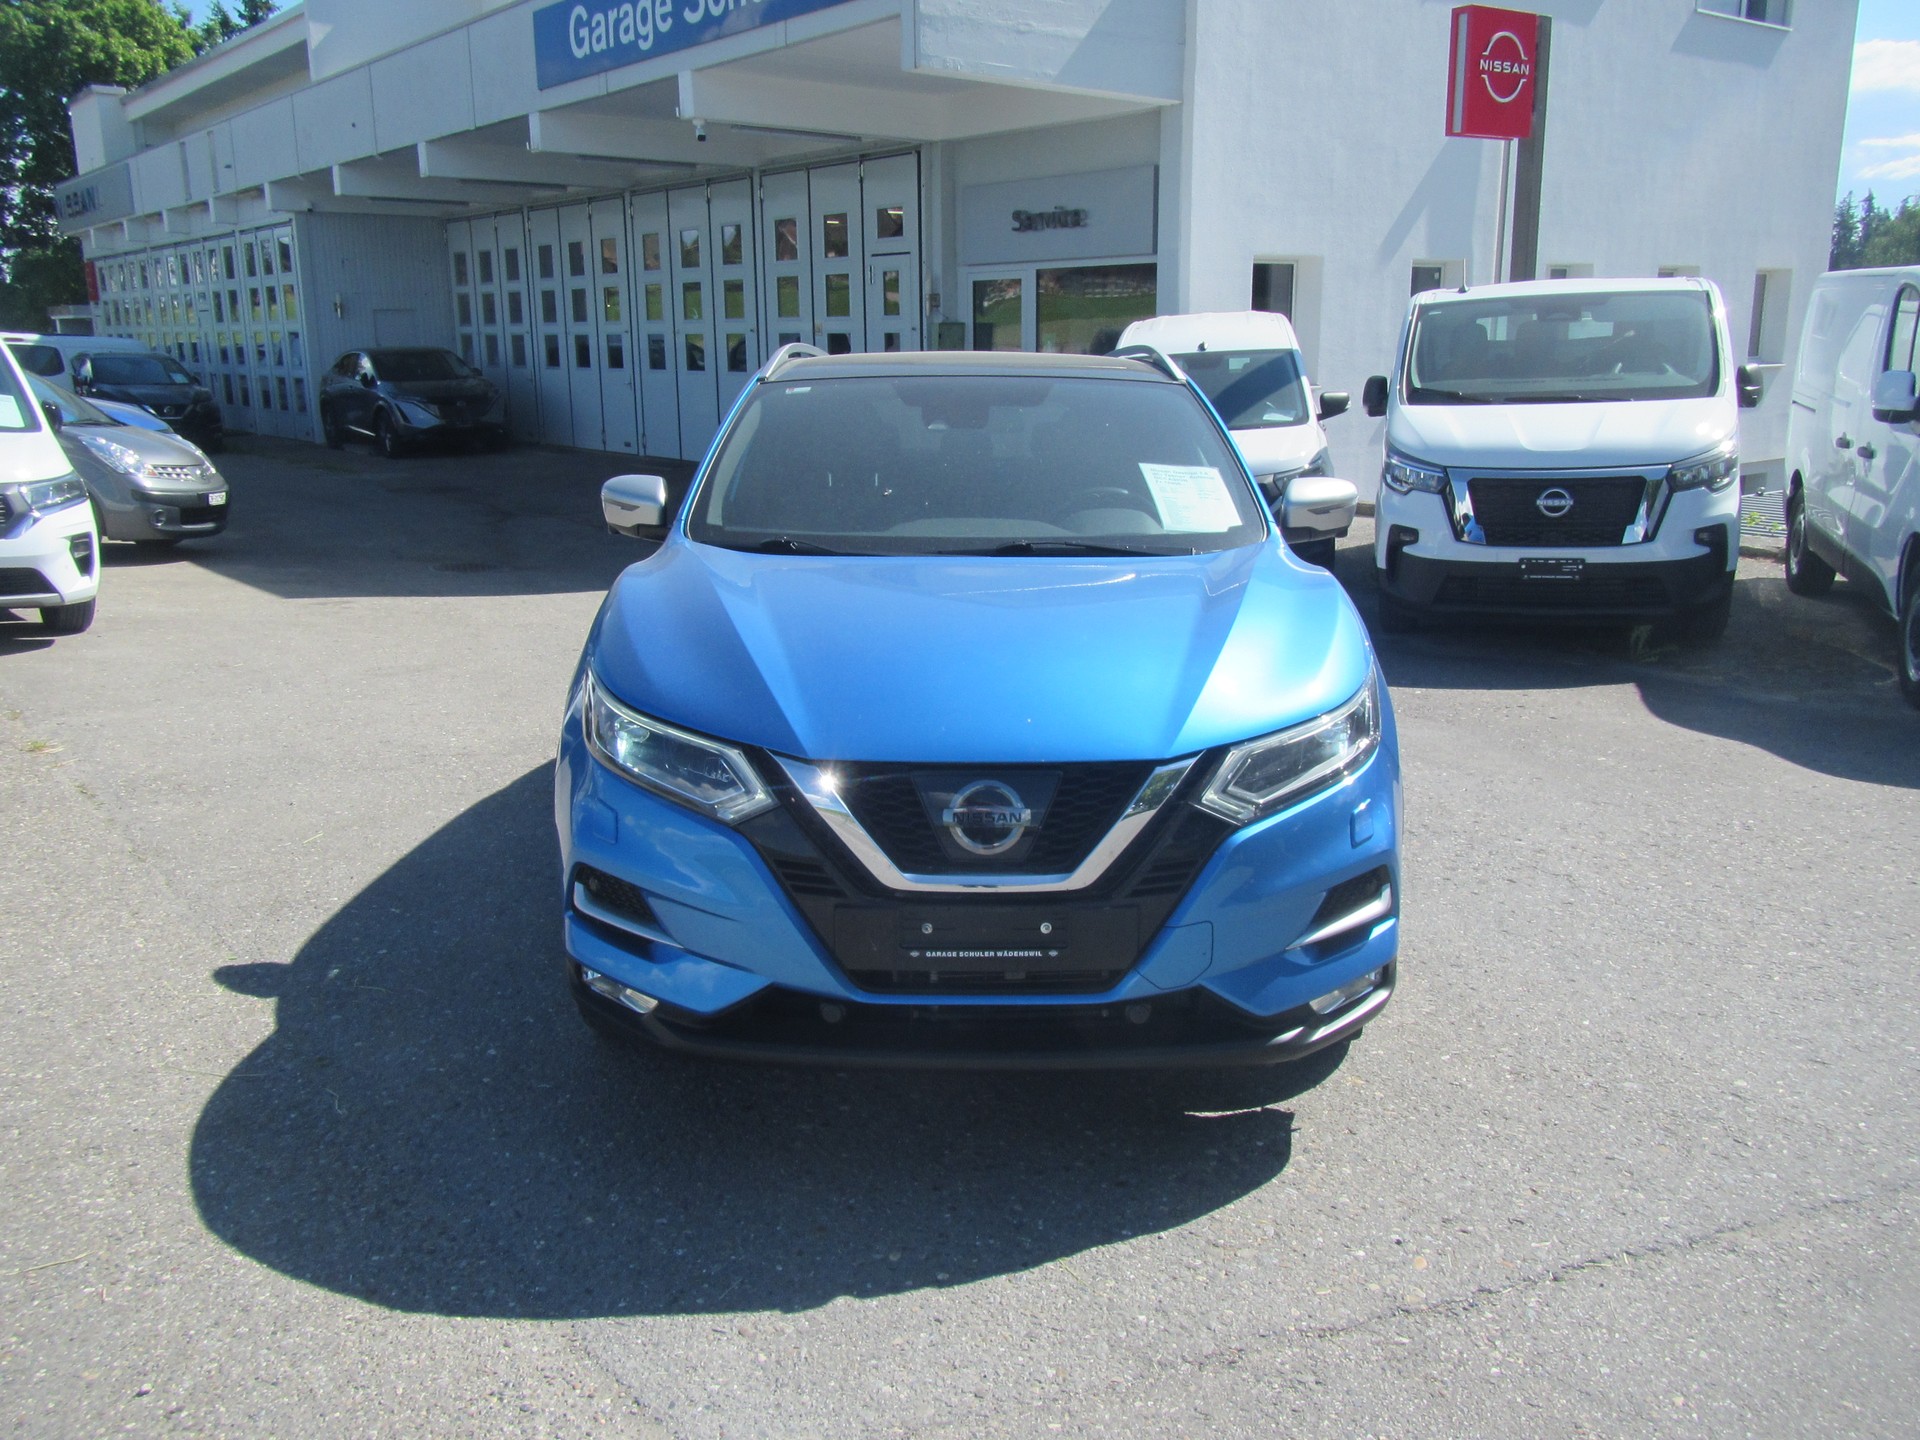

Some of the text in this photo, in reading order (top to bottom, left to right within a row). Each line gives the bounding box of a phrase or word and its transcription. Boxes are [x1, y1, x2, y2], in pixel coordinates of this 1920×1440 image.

[569, 0, 673, 59] Garage
[1479, 58, 1530, 76] NISSAN
[1011, 205, 1088, 232] Service
[1536, 498, 1574, 507] NISSAN
[952, 811, 1023, 824] NISSAN
[925, 950, 957, 958] GARAGE
[958, 950, 995, 958] SCHULER
